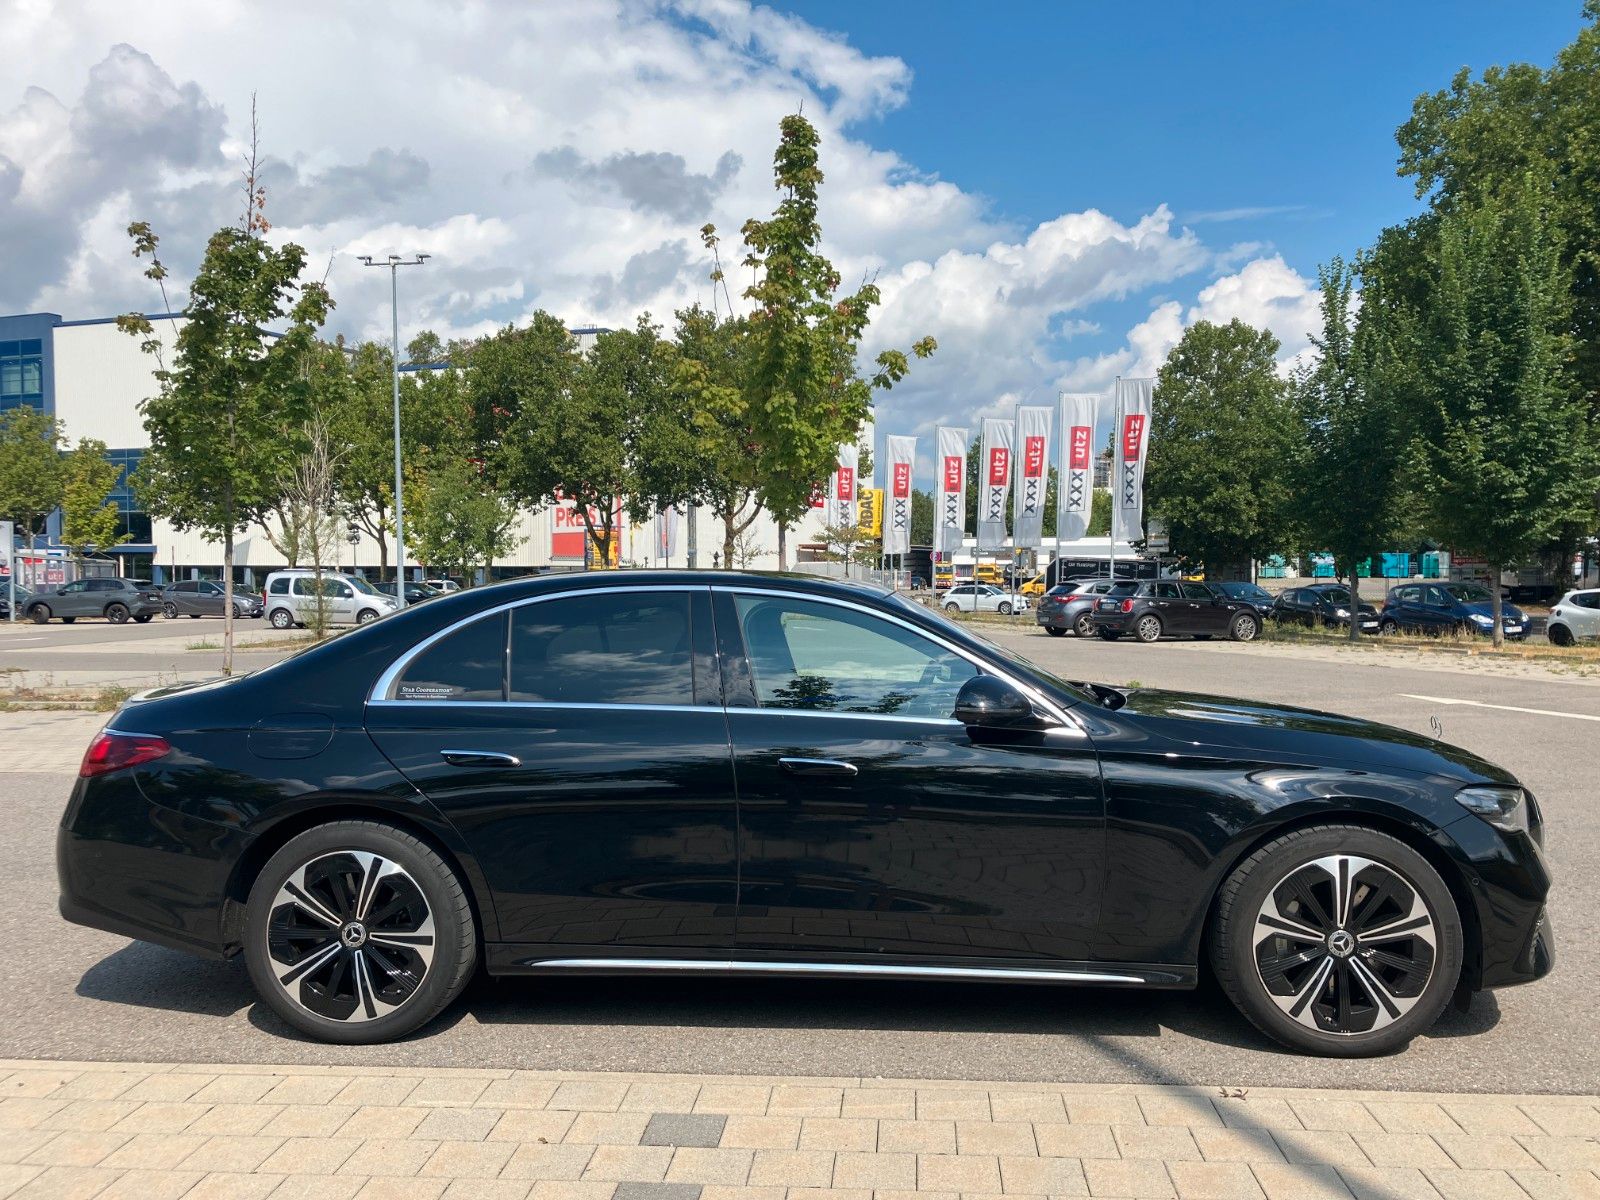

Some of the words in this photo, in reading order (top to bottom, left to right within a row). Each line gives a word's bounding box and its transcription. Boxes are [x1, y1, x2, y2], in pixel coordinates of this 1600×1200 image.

[894, 467, 907, 528] XXXLutz
[946, 460, 959, 525] XXXLutz
[990, 451, 1006, 519] XXXLutz
[1025, 441, 1042, 513] XXXLutz
[1070, 431, 1087, 507] XXXLutz
[860, 490, 874, 529] ADAC
